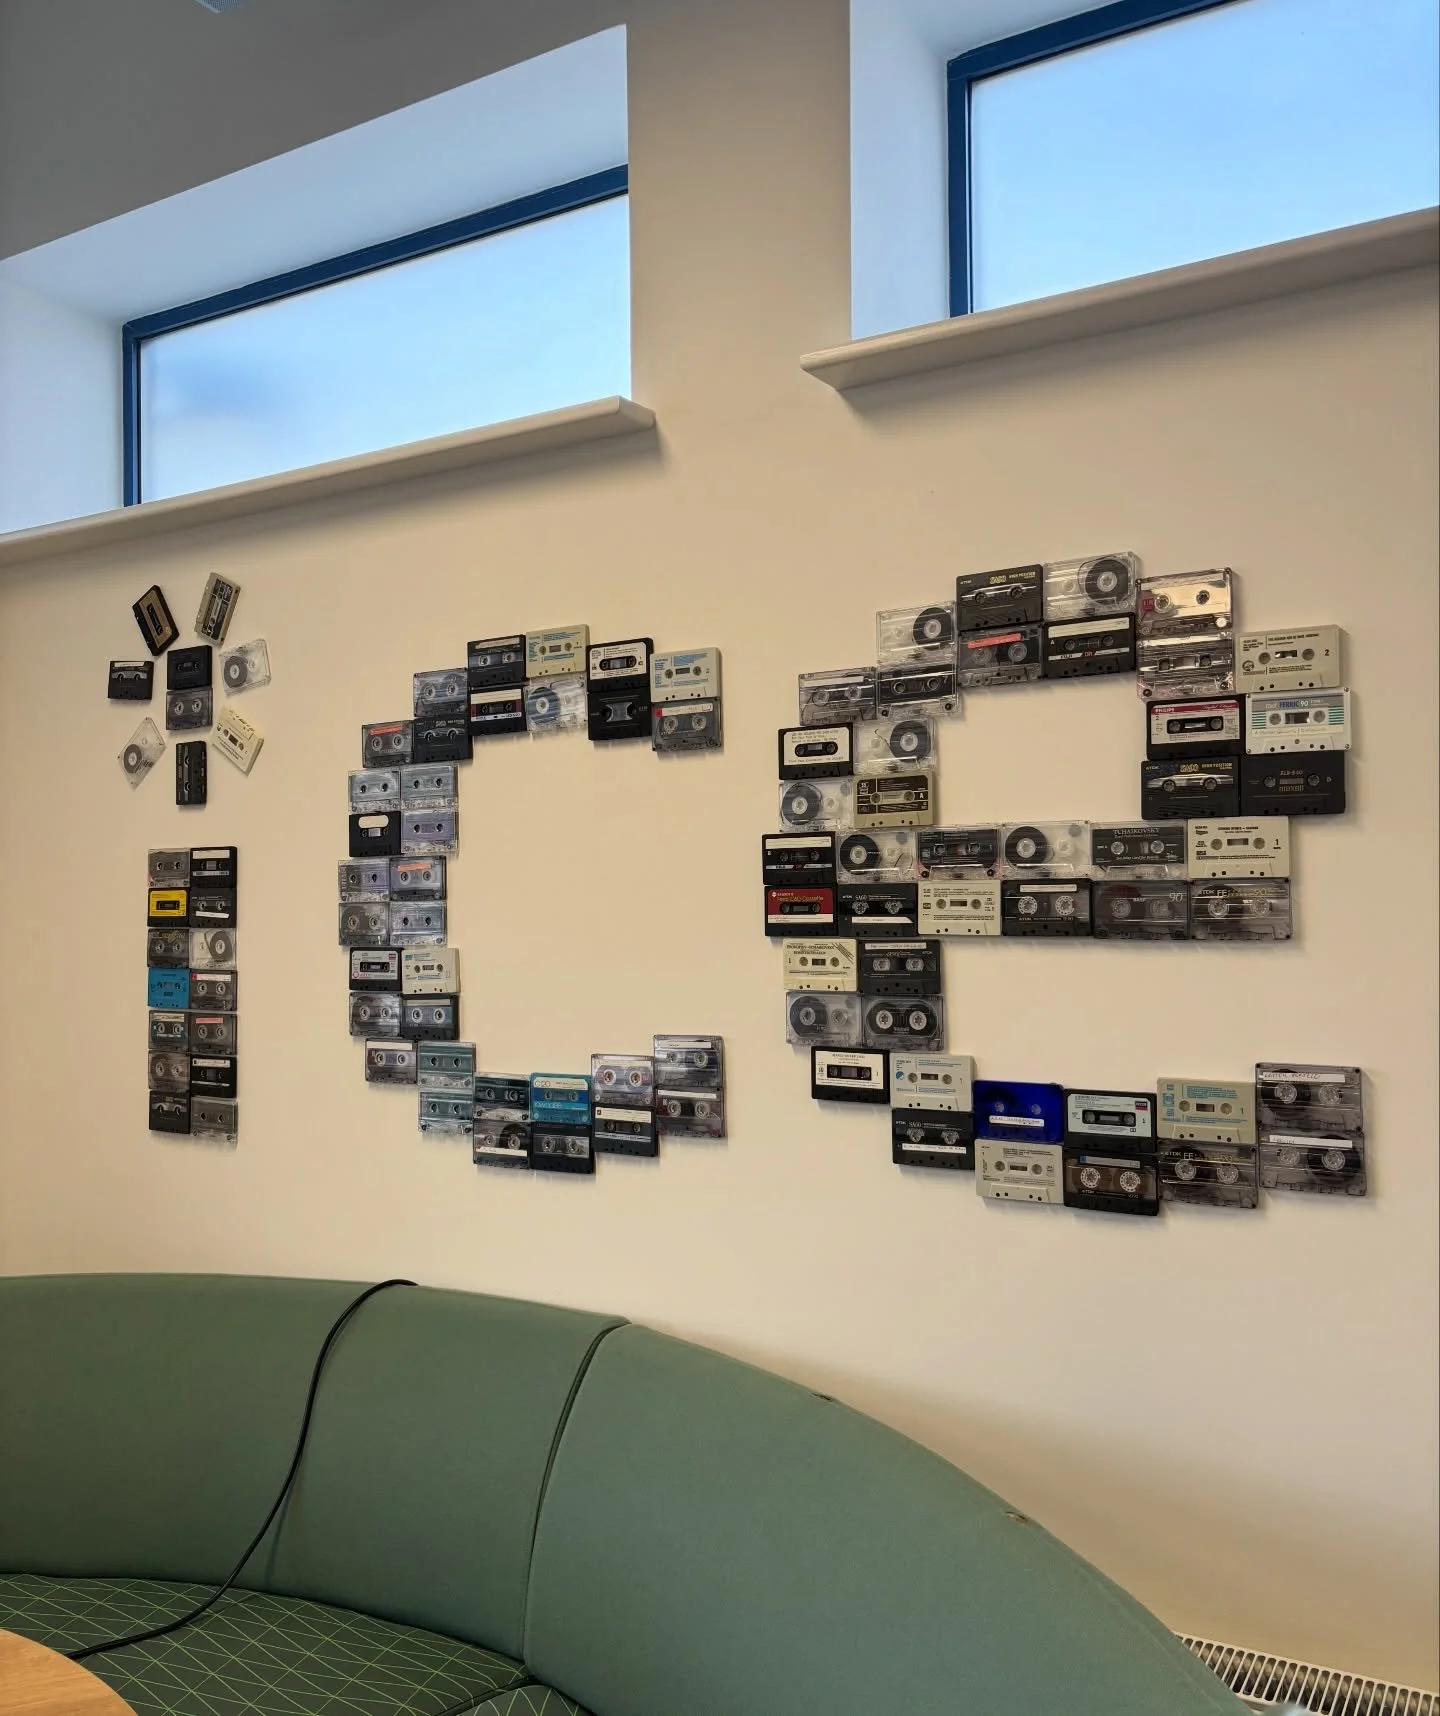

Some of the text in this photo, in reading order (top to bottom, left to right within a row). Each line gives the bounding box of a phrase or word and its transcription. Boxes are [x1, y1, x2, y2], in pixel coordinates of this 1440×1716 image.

[1169, 892, 1183, 902] 90
[1216, 889, 1228, 897] FE
[1241, 1107, 1244, 1115] 1
